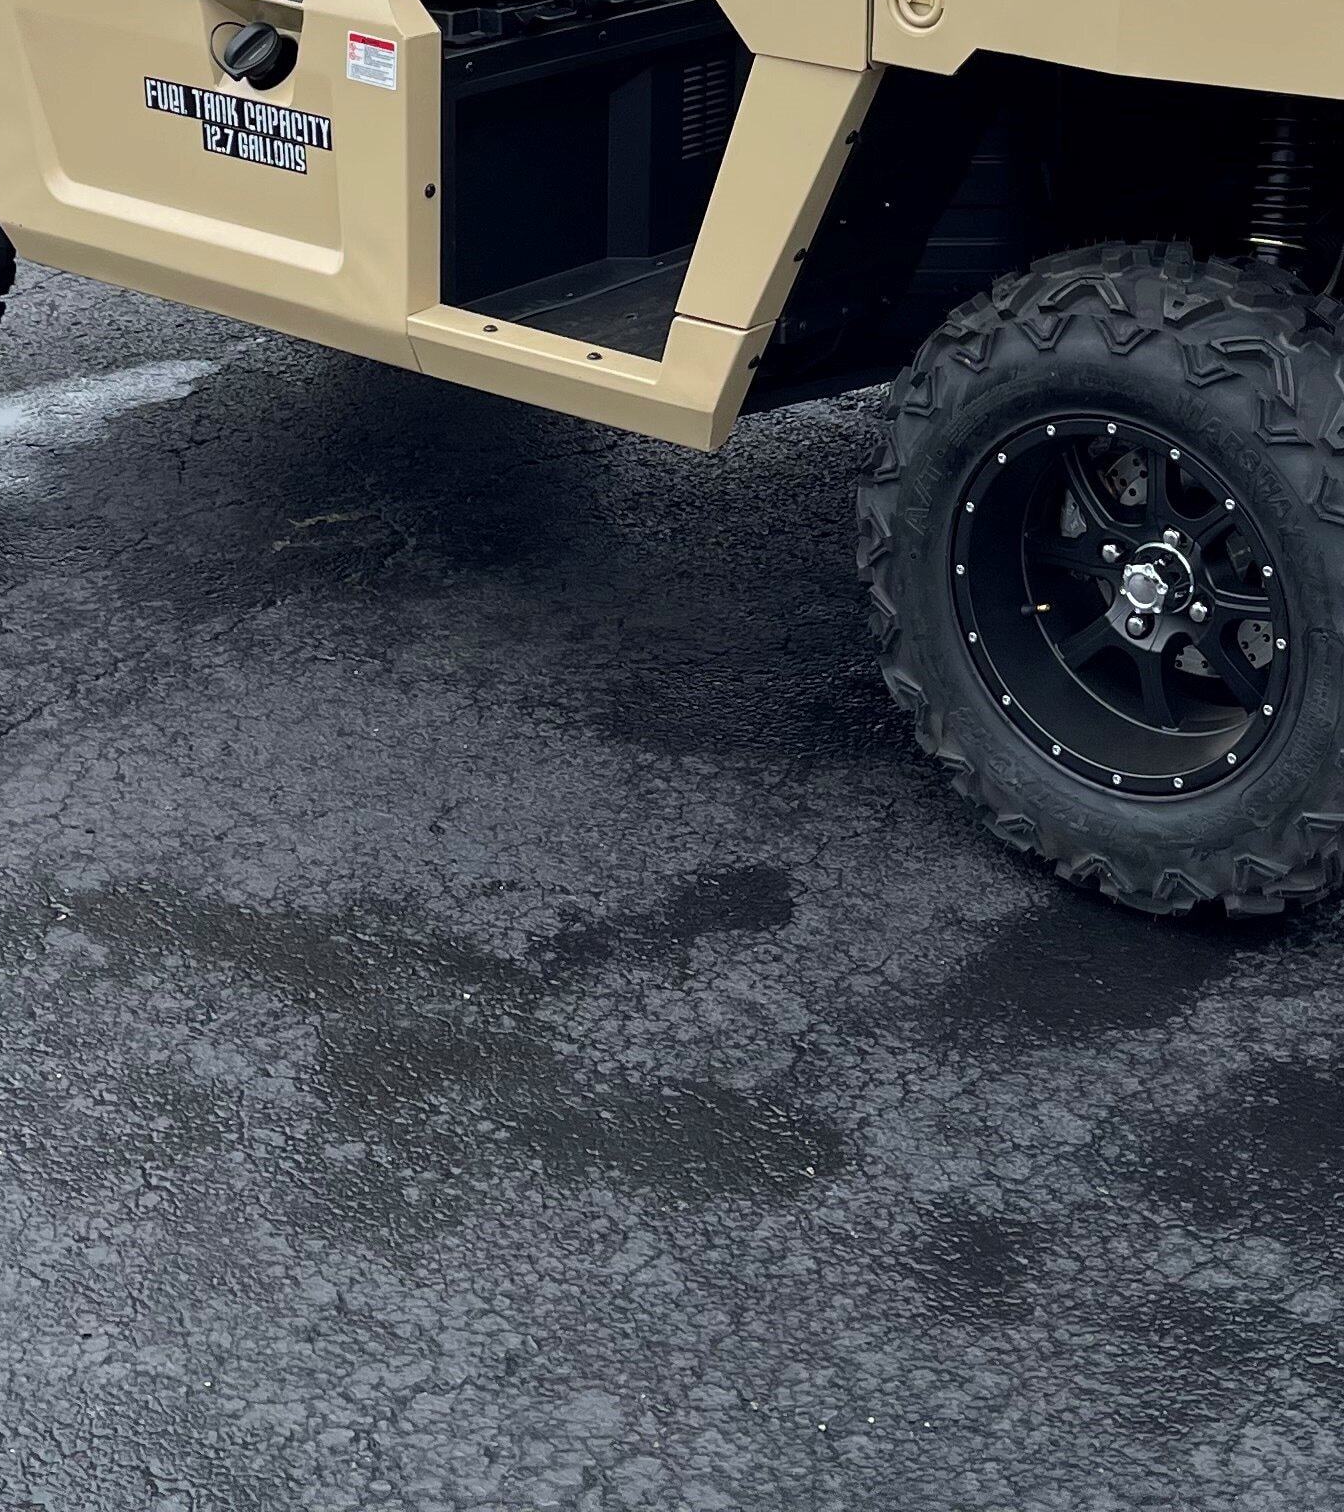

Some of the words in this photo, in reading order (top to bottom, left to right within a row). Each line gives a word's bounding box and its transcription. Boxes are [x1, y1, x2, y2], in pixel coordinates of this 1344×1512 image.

[192, 89, 238, 126] TANK
[244, 101, 329, 148] CAPACITY
[204, 124, 234, 154] 12.7
[238, 132, 306, 171] GALLONS
